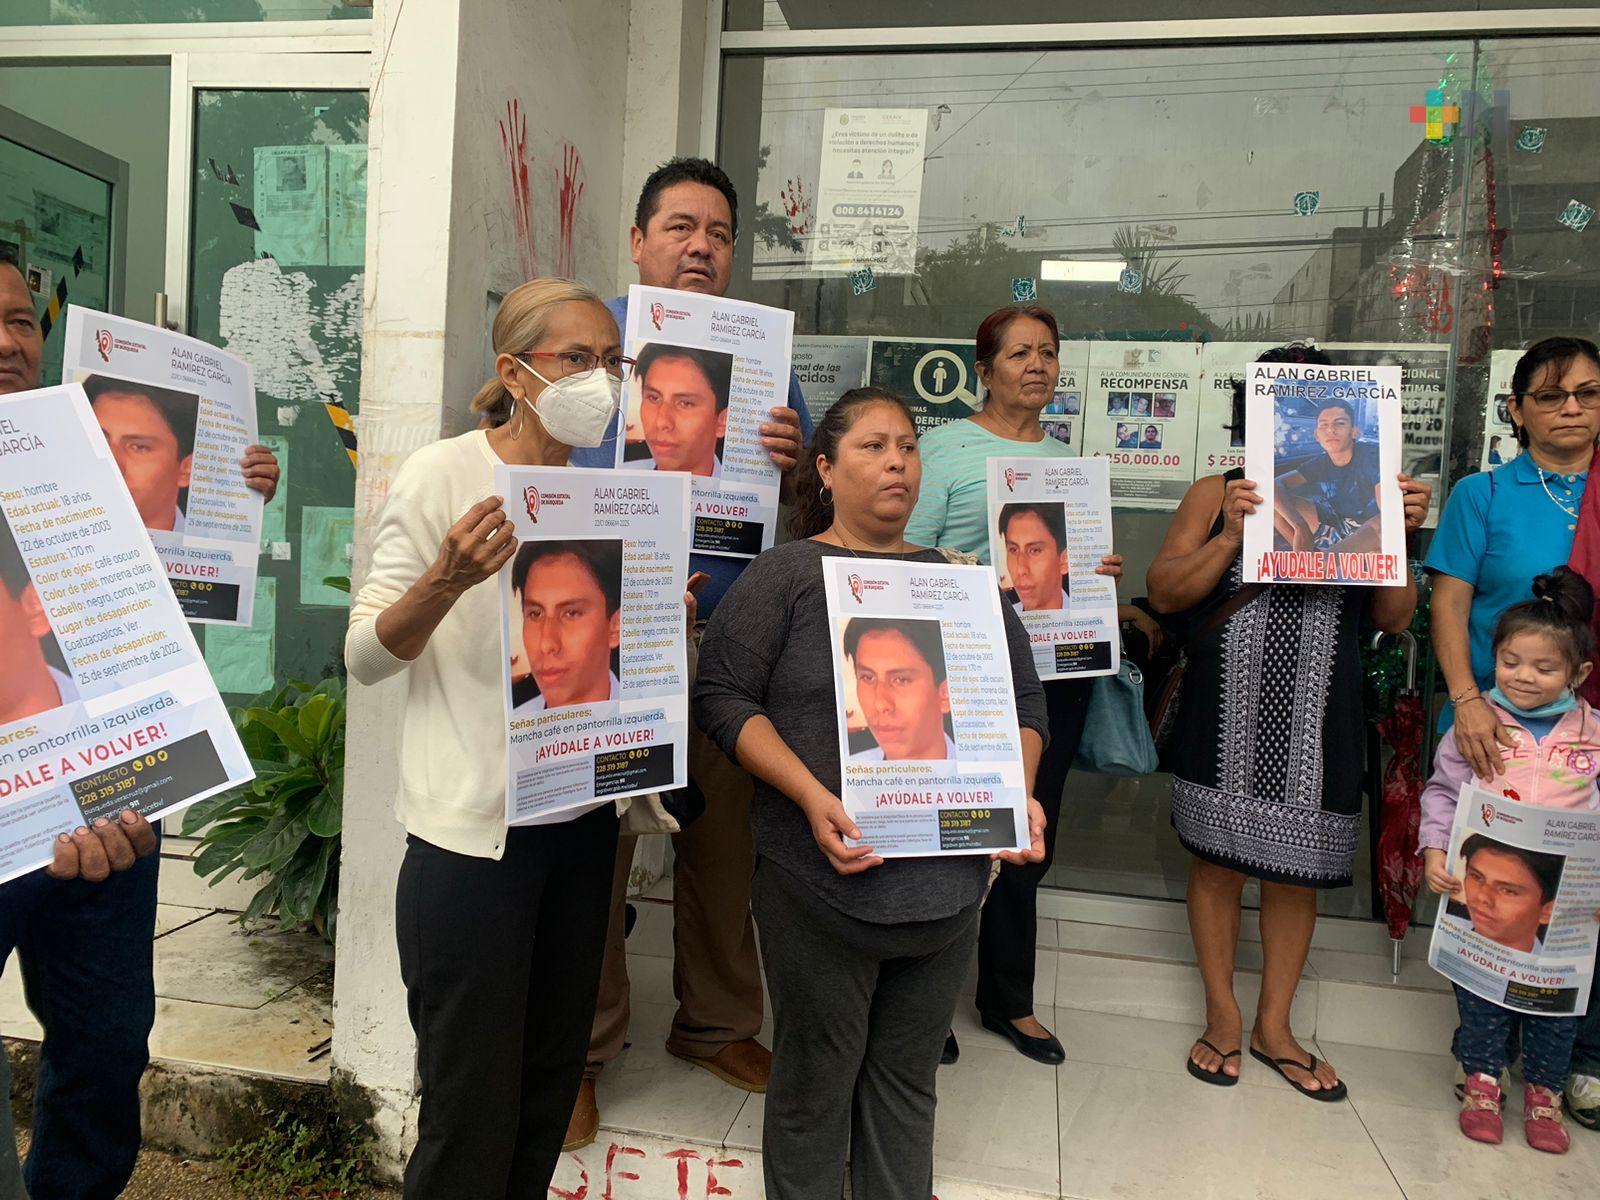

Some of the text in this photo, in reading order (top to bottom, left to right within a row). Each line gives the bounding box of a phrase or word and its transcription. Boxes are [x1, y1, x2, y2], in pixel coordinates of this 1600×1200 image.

[835, 206, 853, 215] 800
[712, 311, 759, 328] ALAN GABRIEL
[710, 322, 741, 337] RAMÍREZ
[171, 347, 224, 371] ALAN GABRIEL
[792, 353, 813, 361] gosto
[812, 363, 824, 372] de
[1254, 367, 1376, 382] ALAN GABRIEL
[1100, 378, 1188, 390] RECOMPENSA
[1254, 384, 1398, 400] RAMÍREZ GARCÍA
[1044, 468, 1082, 476] ALAN GABRIEL
[0, 481, 58, 502] Sexo: hombre
[594, 488, 650, 500] ALAN GABRIEL
[722, 492, 760, 504] izquierda.
[6, 491, 92, 519] Edad actual: 18 años
[594, 501, 660, 516] RAMÍREZ GARCÍA
[695, 503, 748, 517] A VOLVER!
[14, 506, 106, 535] Fecha de nacimiento:
[20, 520, 112, 552] 22 de octubre de 2003
[28, 551, 68, 569] Estatura:
[86, 544, 96, 554] m
[187, 548, 234, 562] izquierda.
[36, 549, 140, 586] Color de ojos: café oscuro
[166, 562, 219, 578] VOLVER!
[1326, 552, 1338, 580] A
[1339, 553, 1398, 580] VOLVER!
[42, 562, 152, 602] Color de piel: morena clara
[910, 577, 960, 589] ALAN GABRIEL
[50, 600, 86, 618] Cabello:
[136, 580, 156, 593] lacio
[911, 588, 942, 601] RAMÍREZ
[56, 600, 152, 637] Lugar de desaparición:
[64, 620, 142, 652] Coatzacoalcos, Ver.
[1061, 630, 1096, 640] VOLVER!
[72, 630, 168, 669] Fecha de desaparición:
[78, 673, 91, 686] 25
[91, 669, 103, 682] de
[103, 654, 150, 679] septiembre
[150, 650, 162, 662] de
[510, 708, 592, 731] Señas particulares:
[18, 724, 100, 762] pantorrilla
[102, 695, 179, 730] izquierda.
[510, 712, 667, 745] Mancha café en pantorrilla izquierda.
[60, 757, 76, 776] A
[78, 722, 169, 767] VOLVER!
[535, 729, 654, 764] ¡AYÚDALE A VOLVER!
[596, 752, 627, 764] CONTACTO
[846, 765, 932, 776] Señas particulares:
[74, 766, 129, 793] CONTACTO
[846, 775, 1004, 787] Mancha café en pantorrilla izquierda.
[78, 776, 137, 806] 228 319 3187
[876, 790, 994, 808] ¡AYÚDALE A VOLVER!
[129, 800, 140, 809] 911
[940, 810, 969, 818] CONTACTO
[1546, 819, 1596, 831] ALAN GABRIEL
[1456, 946, 1506, 975] ¡AYÚDALE
[1522, 972, 1566, 986] VOLVER!
